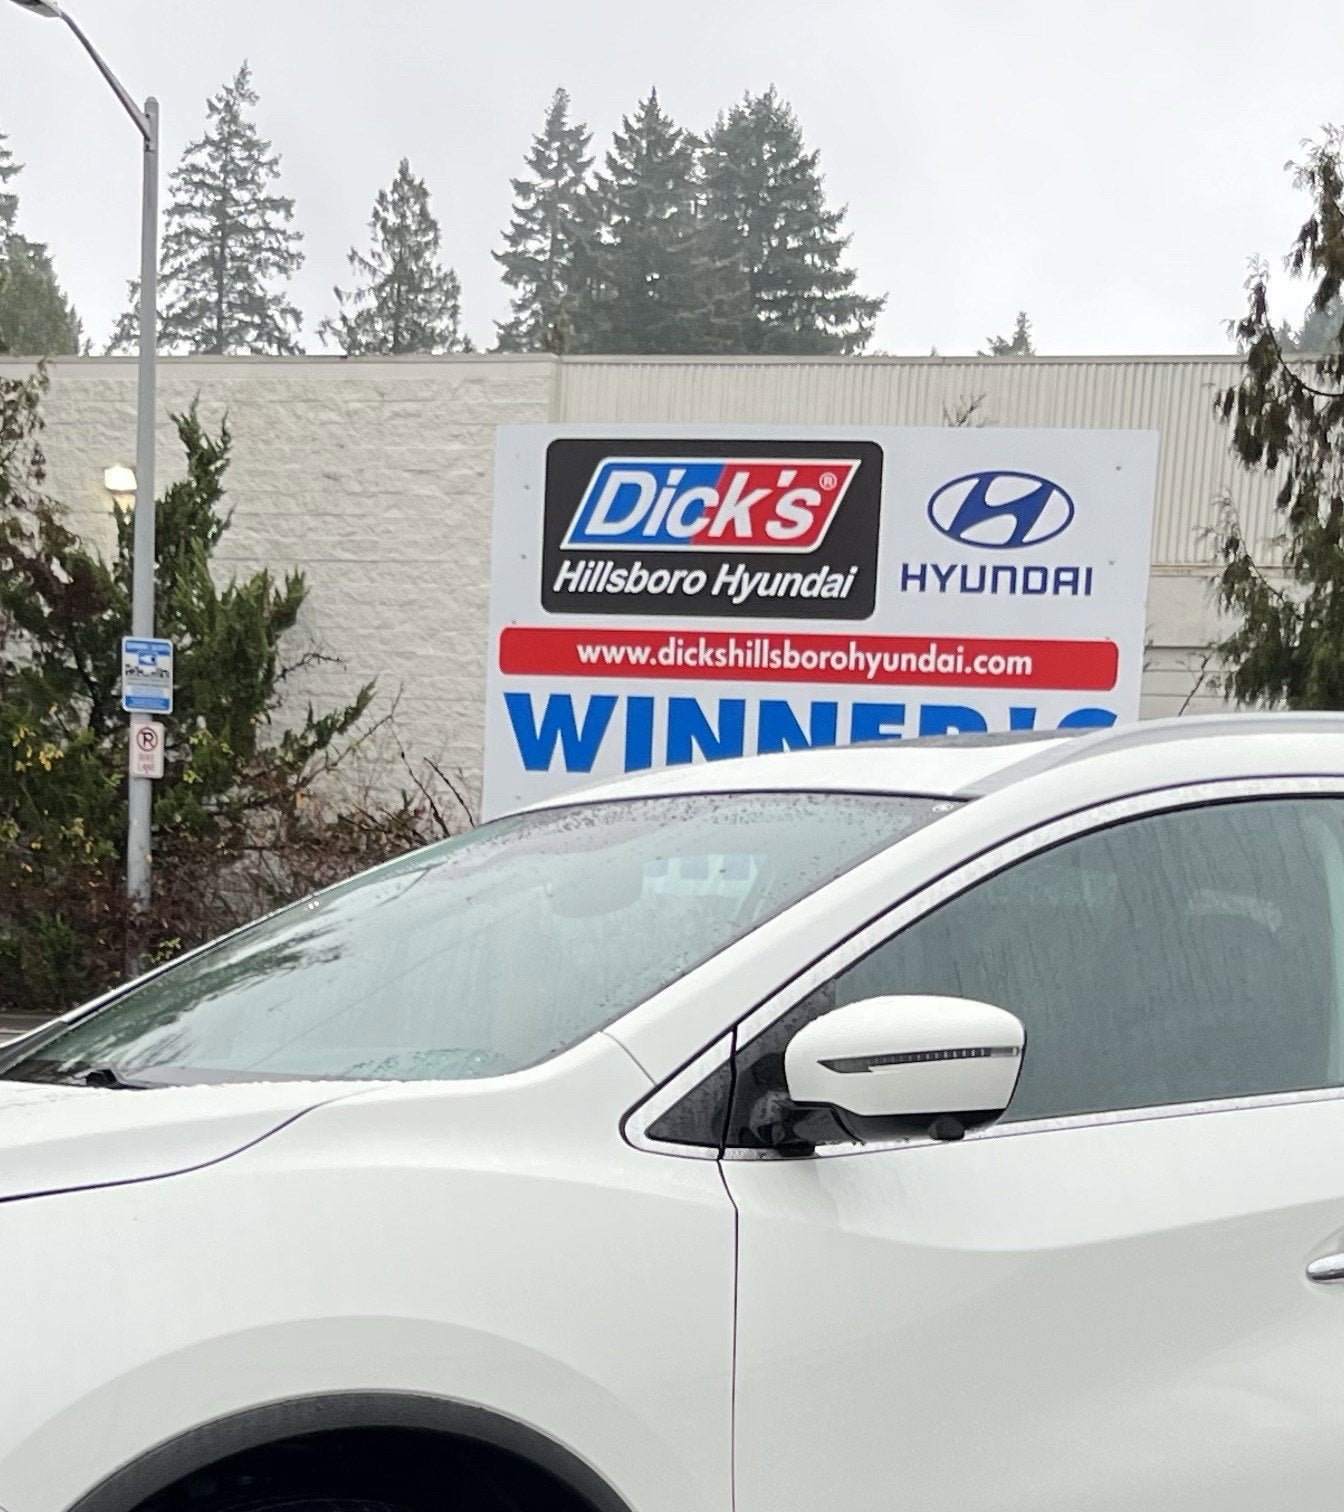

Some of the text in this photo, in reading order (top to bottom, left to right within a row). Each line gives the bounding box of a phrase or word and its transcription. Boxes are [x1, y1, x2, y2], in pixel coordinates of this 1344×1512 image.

[584, 468, 822, 540] Dick's
[553, 560, 859, 604] Hillsboro Hyundai
[901, 562, 1093, 597] HYUNDAI
[576, 638, 1033, 681] www.dickshillsborohyundai.com
